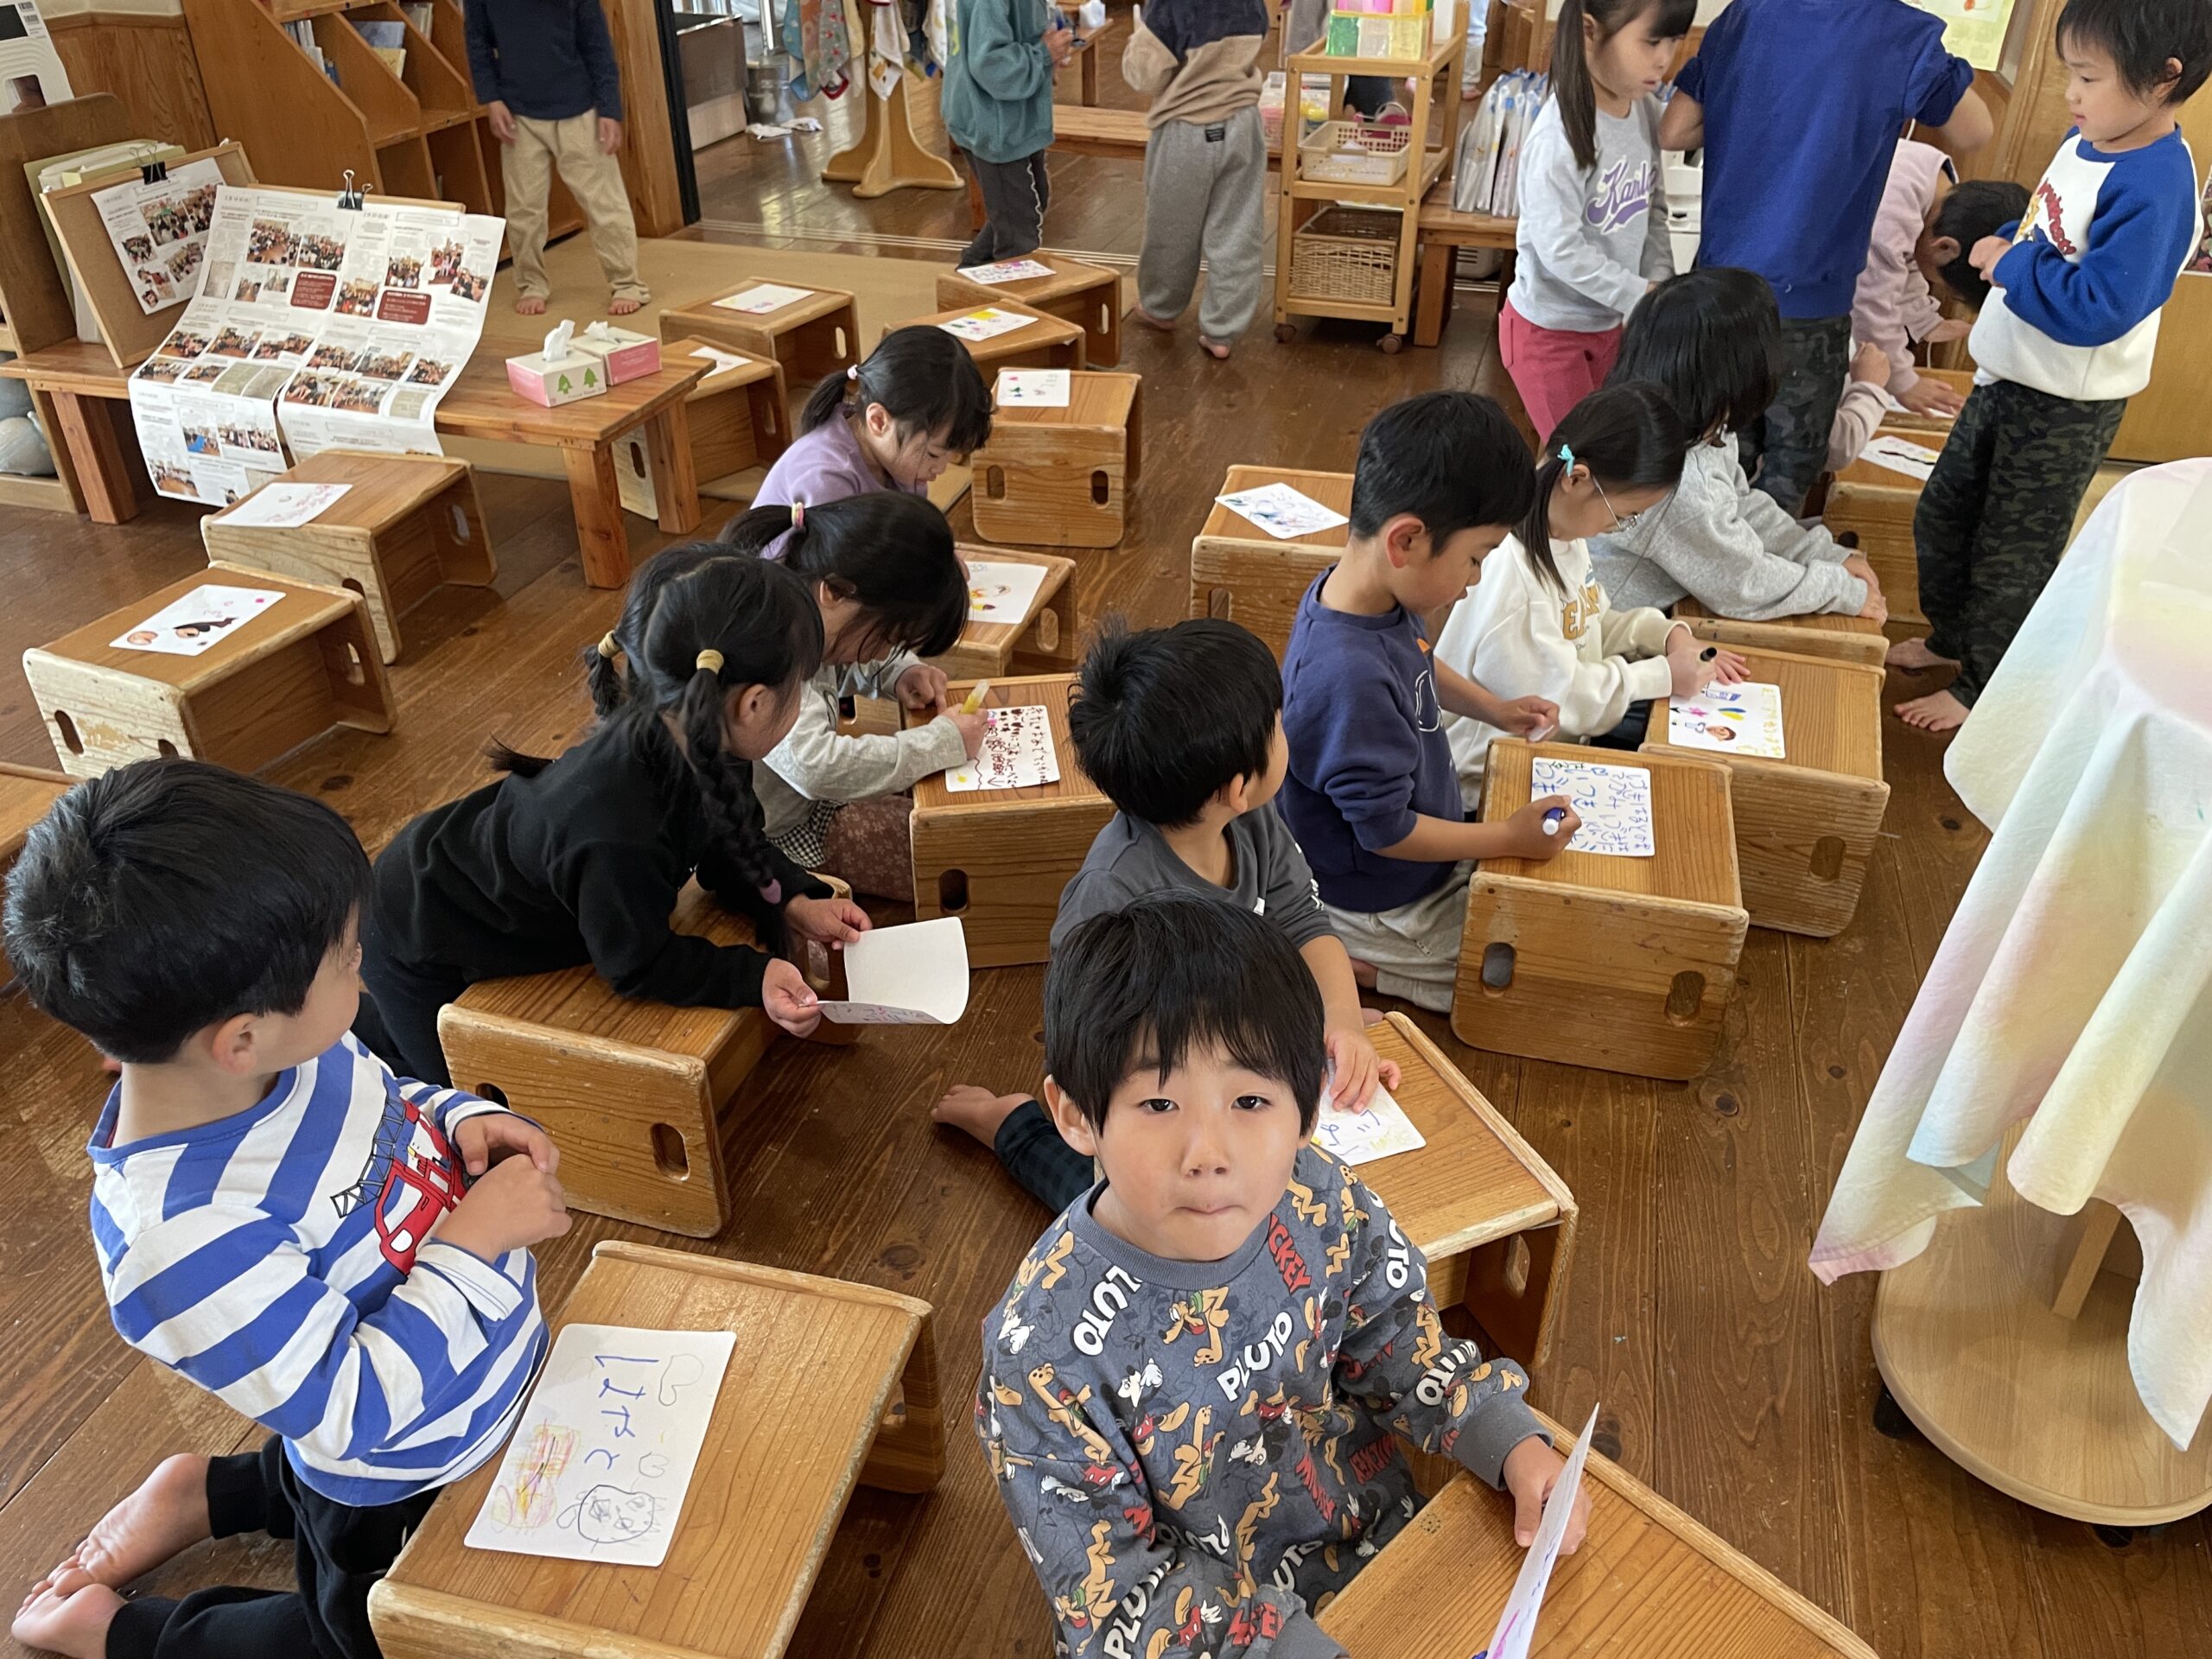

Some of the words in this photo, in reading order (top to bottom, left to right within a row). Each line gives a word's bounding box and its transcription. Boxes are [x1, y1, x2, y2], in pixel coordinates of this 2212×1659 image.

[1268, 1211, 1312, 1294] ICKEY
[1073, 1265, 1143, 1356] LUTO
[1216, 1311, 1294, 1402] PLUTO
